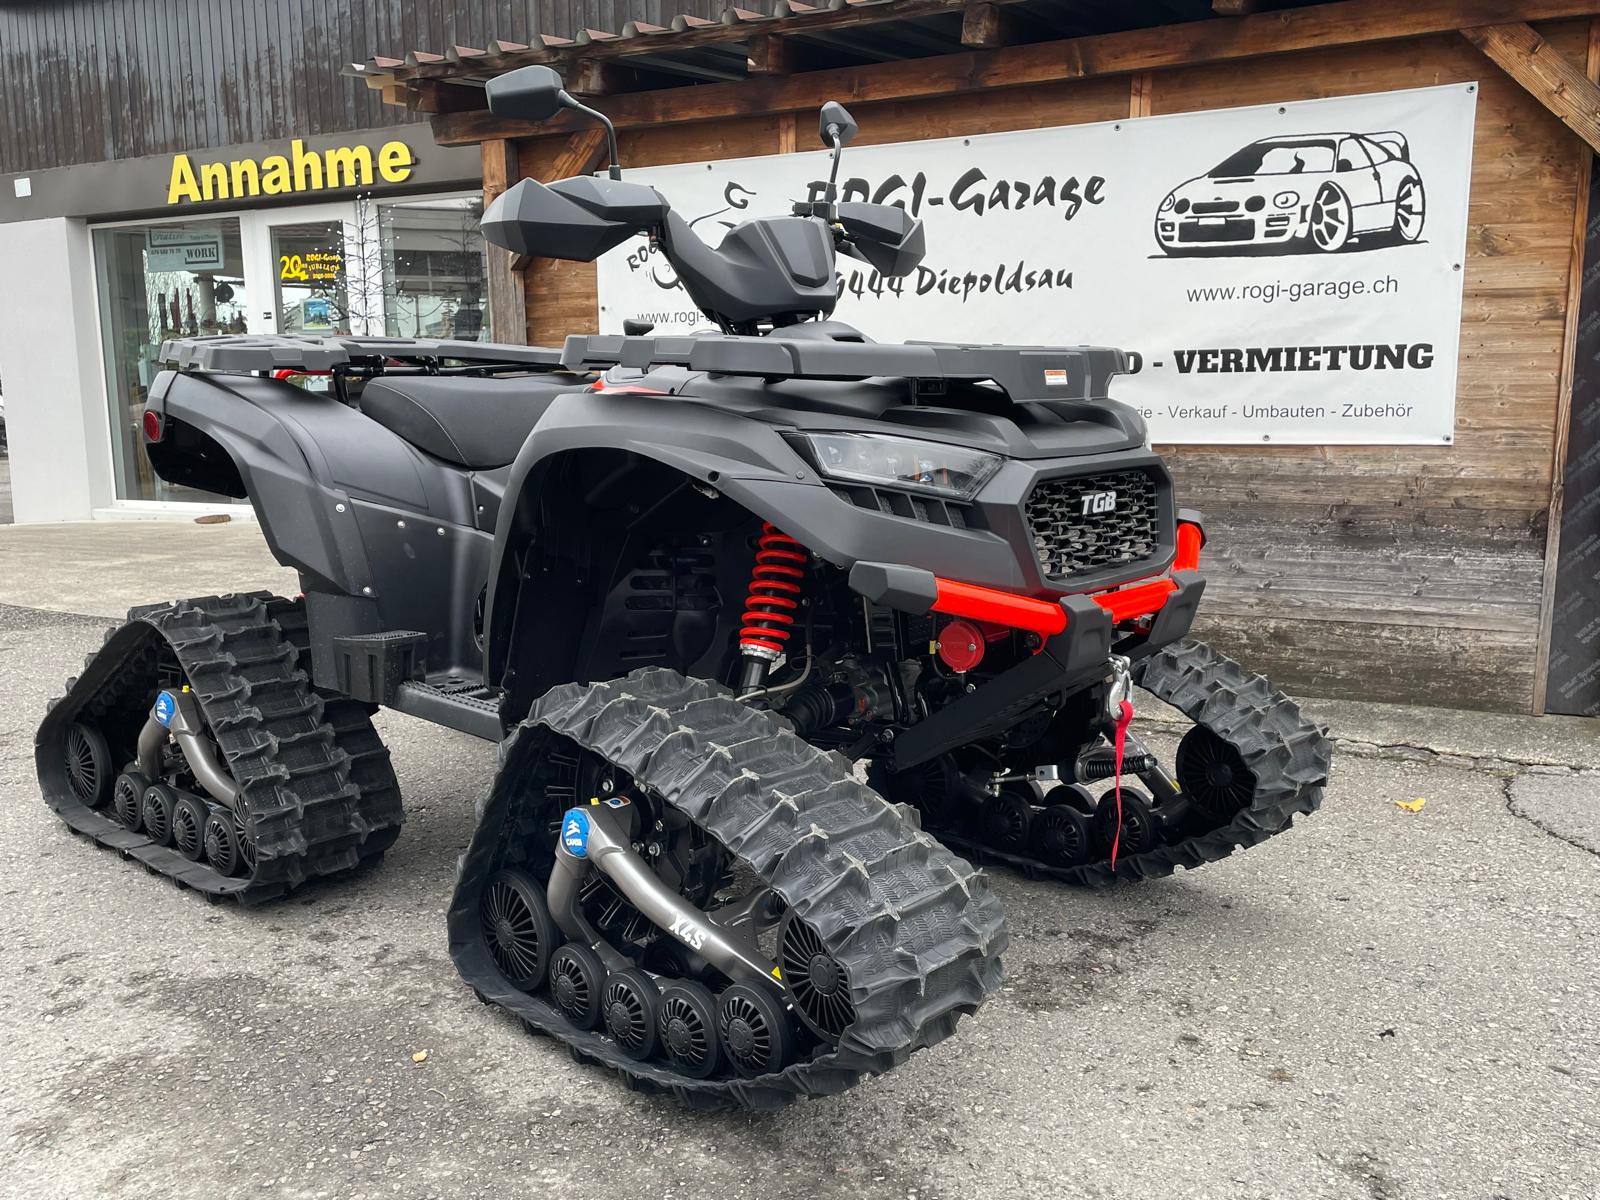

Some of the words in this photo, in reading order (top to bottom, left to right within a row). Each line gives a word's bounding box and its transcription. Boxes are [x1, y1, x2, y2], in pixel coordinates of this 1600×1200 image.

[167, 139, 412, 204] Annahme
[186, 247, 216, 259] WORK
[280, 255, 308, 281] 20
[916, 261, 1073, 303] Diepoldsau
[1187, 275, 1398, 303] www.rogi-garage.ch
[637, 311, 712, 327] www.rogi-
[1174, 343, 1434, 374] VERMIETUNG
[1168, 405, 1228, 418] Verkauf
[1243, 404, 1325, 418] Umbauten
[1342, 403, 1413, 418] Zubehör
[1081, 491, 1117, 516] TGB
[668, 912, 707, 950] X4S
